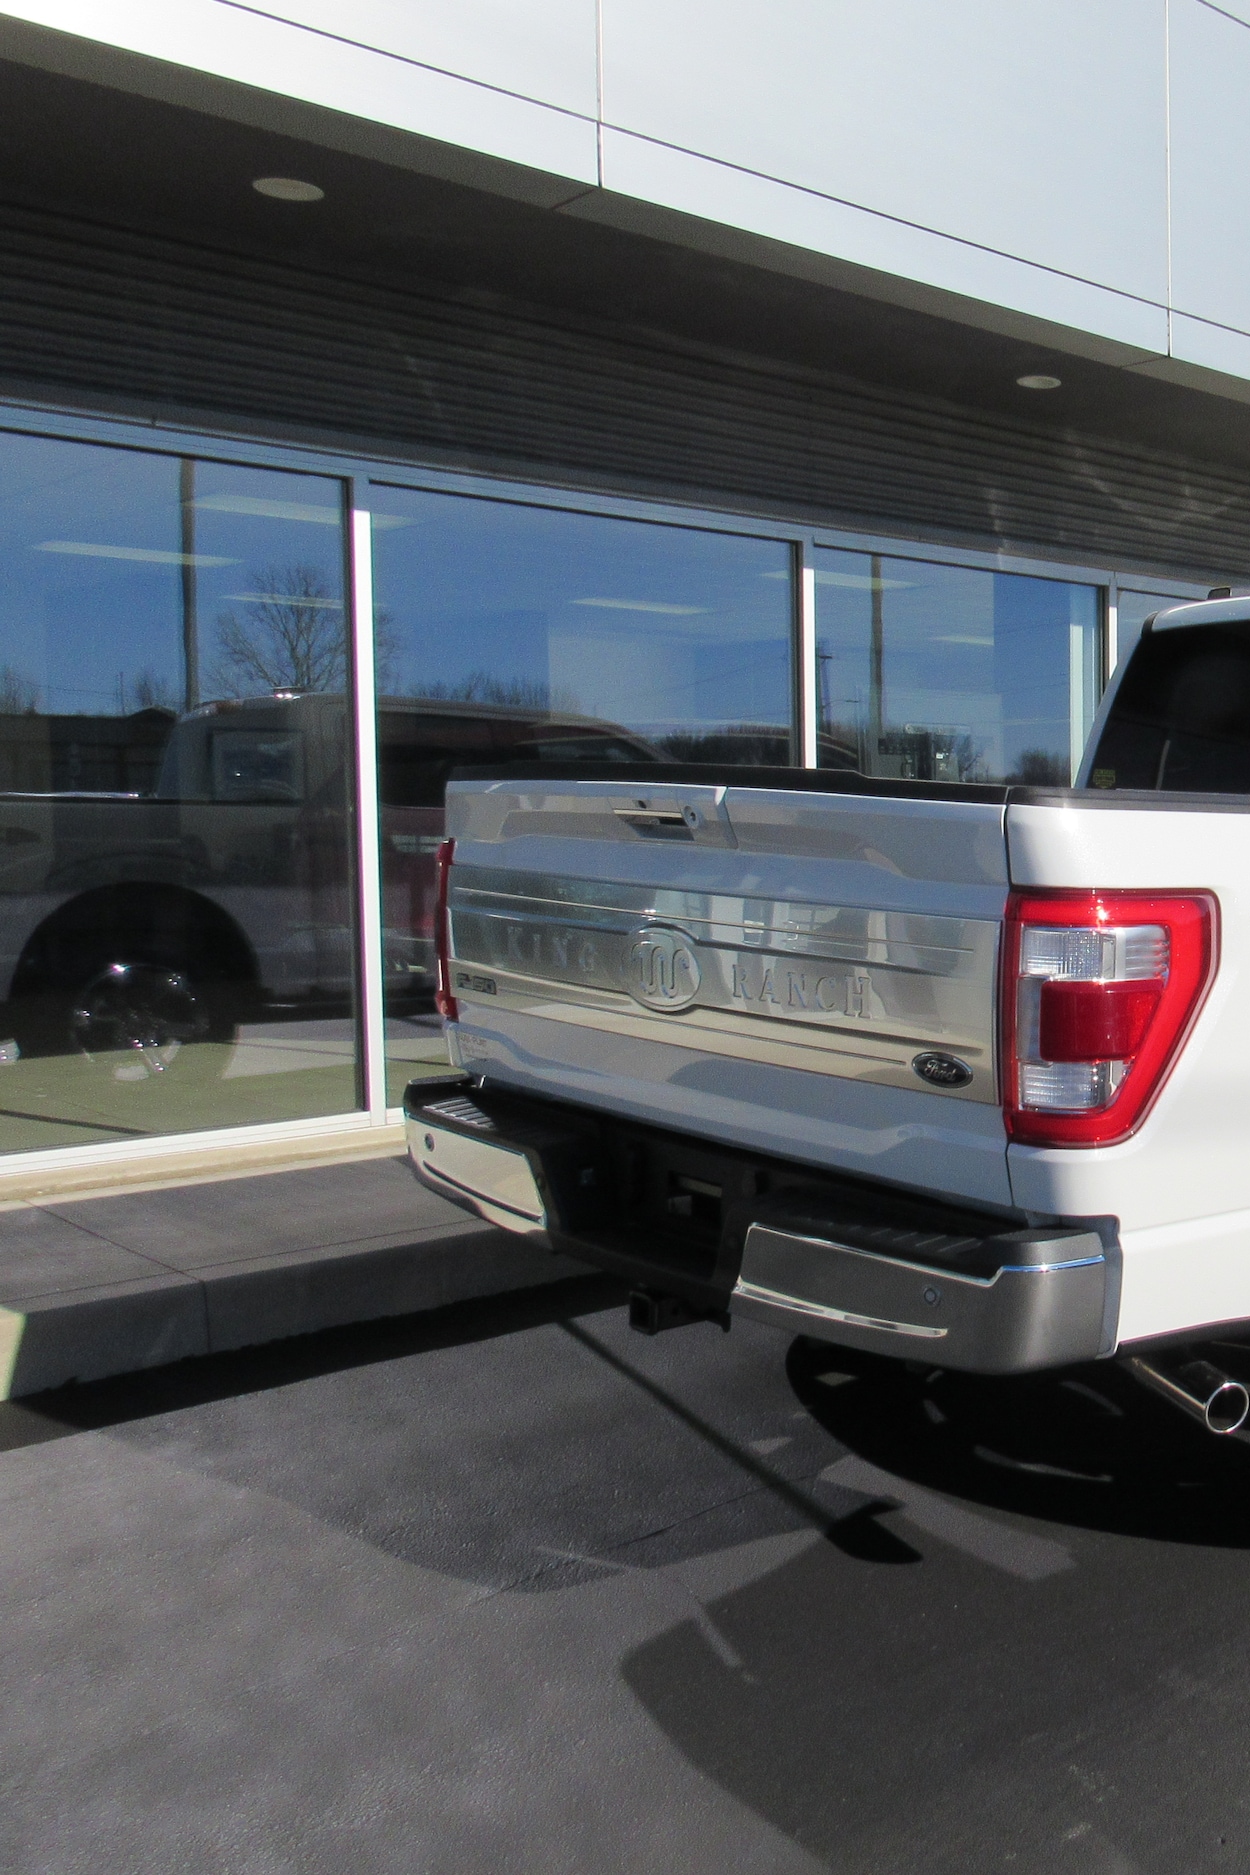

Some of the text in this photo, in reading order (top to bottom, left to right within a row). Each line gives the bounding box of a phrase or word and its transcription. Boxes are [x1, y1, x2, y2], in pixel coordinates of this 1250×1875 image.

[507, 926, 873, 1019] KING RANCH
[924, 1060, 957, 1081] Ford
